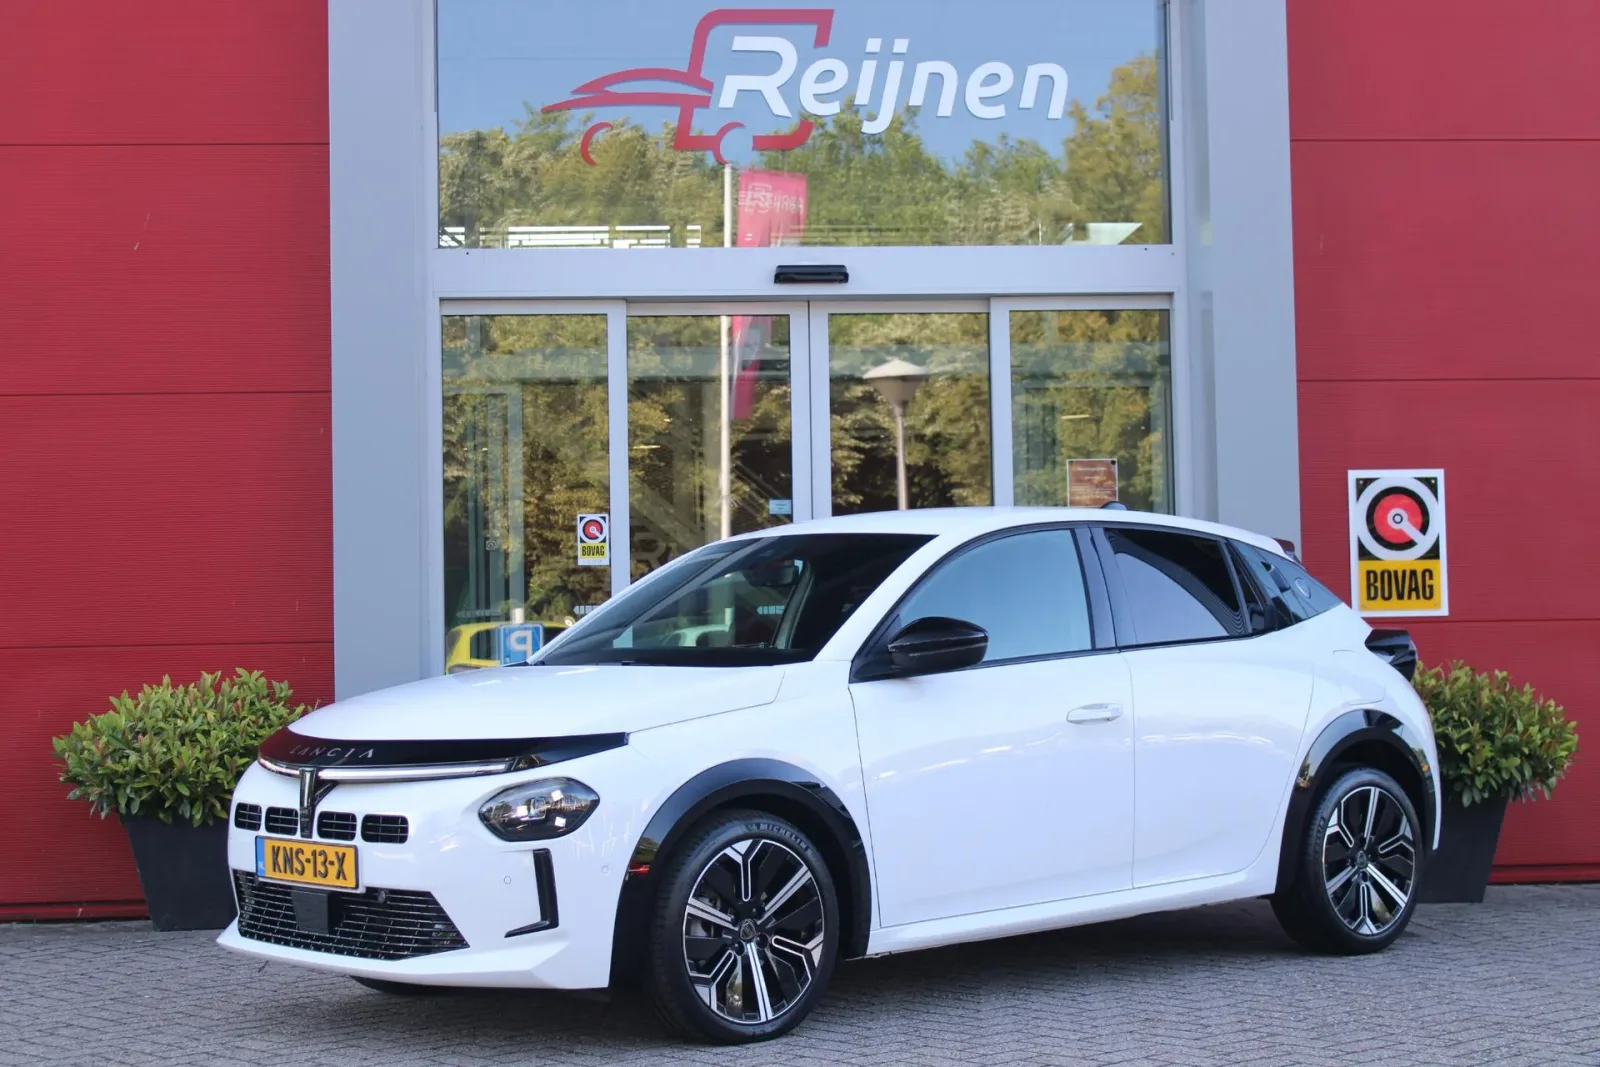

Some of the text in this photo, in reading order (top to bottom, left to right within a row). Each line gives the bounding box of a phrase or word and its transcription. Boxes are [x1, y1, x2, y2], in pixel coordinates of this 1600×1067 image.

[718, 36, 1068, 134] Reijnen
[581, 545, 605, 557] BOVAG
[1366, 568, 1434, 601] BOVAG
[289, 744, 374, 758] LANCIA
[759, 823, 808, 850] MICHELIN
[271, 845, 347, 881] KNS-13-X
